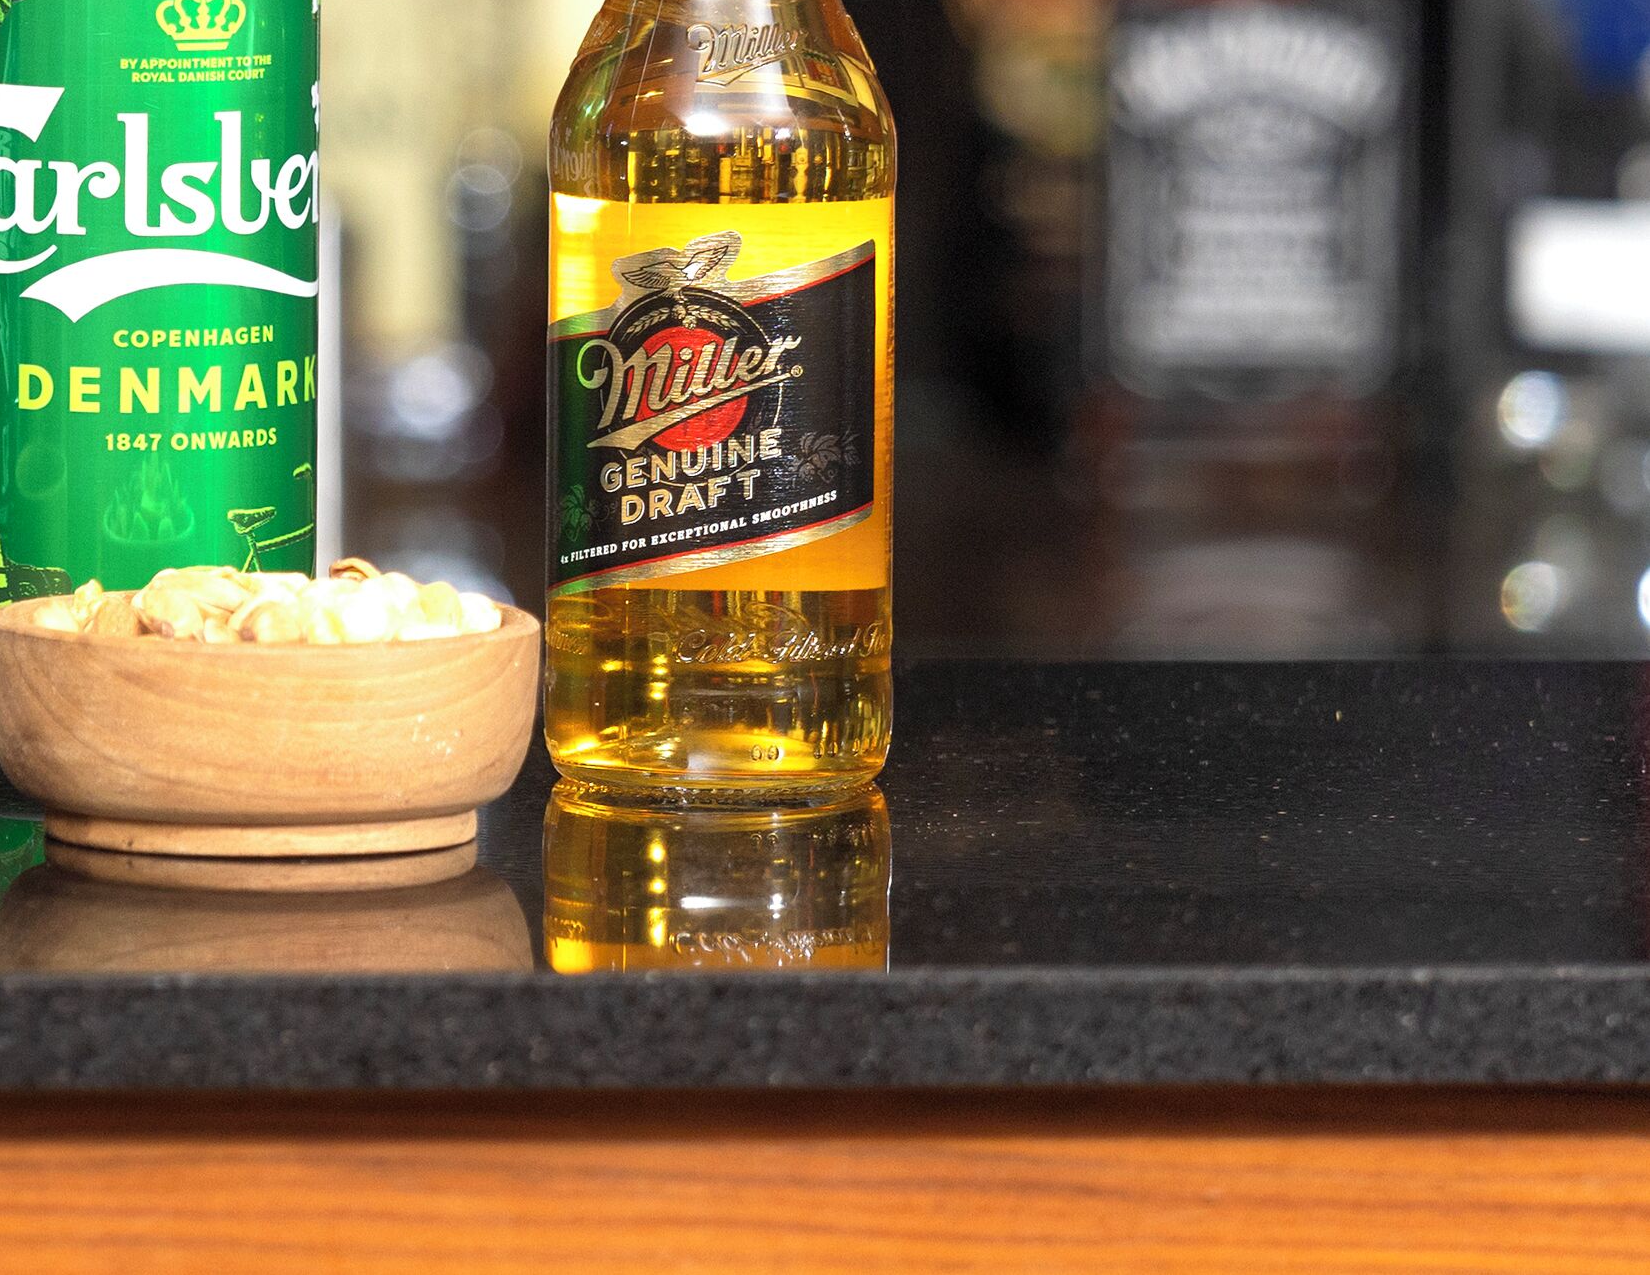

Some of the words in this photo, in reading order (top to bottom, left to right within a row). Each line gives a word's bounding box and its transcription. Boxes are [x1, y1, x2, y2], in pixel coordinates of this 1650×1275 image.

[119, 58, 138, 70] BY
[139, 57, 234, 69] APPOINTMENT
[236, 56, 252, 68] TO
[252, 55, 272, 66] THE
[131, 72, 175, 83] ROYAL
[178, 71, 226, 82] DANISH
[228, 68, 266, 81] COURT
[113, 325, 274, 349] COPENHAGEN
[18, 354, 318, 414] DENMARK
[576, 335, 803, 429] Miller
[105, 432, 161, 452] 1847
[170, 427, 278, 451] ONWARDS
[600, 427, 783, 493] GENUINE
[620, 468, 762, 526] DRAFT
[570, 543, 618, 563] FILTERED
[621, 538, 647, 552] FOR
[651, 517, 748, 547] EXCEPTIONAL
[751, 490, 839, 526] SMOOTHNESS
